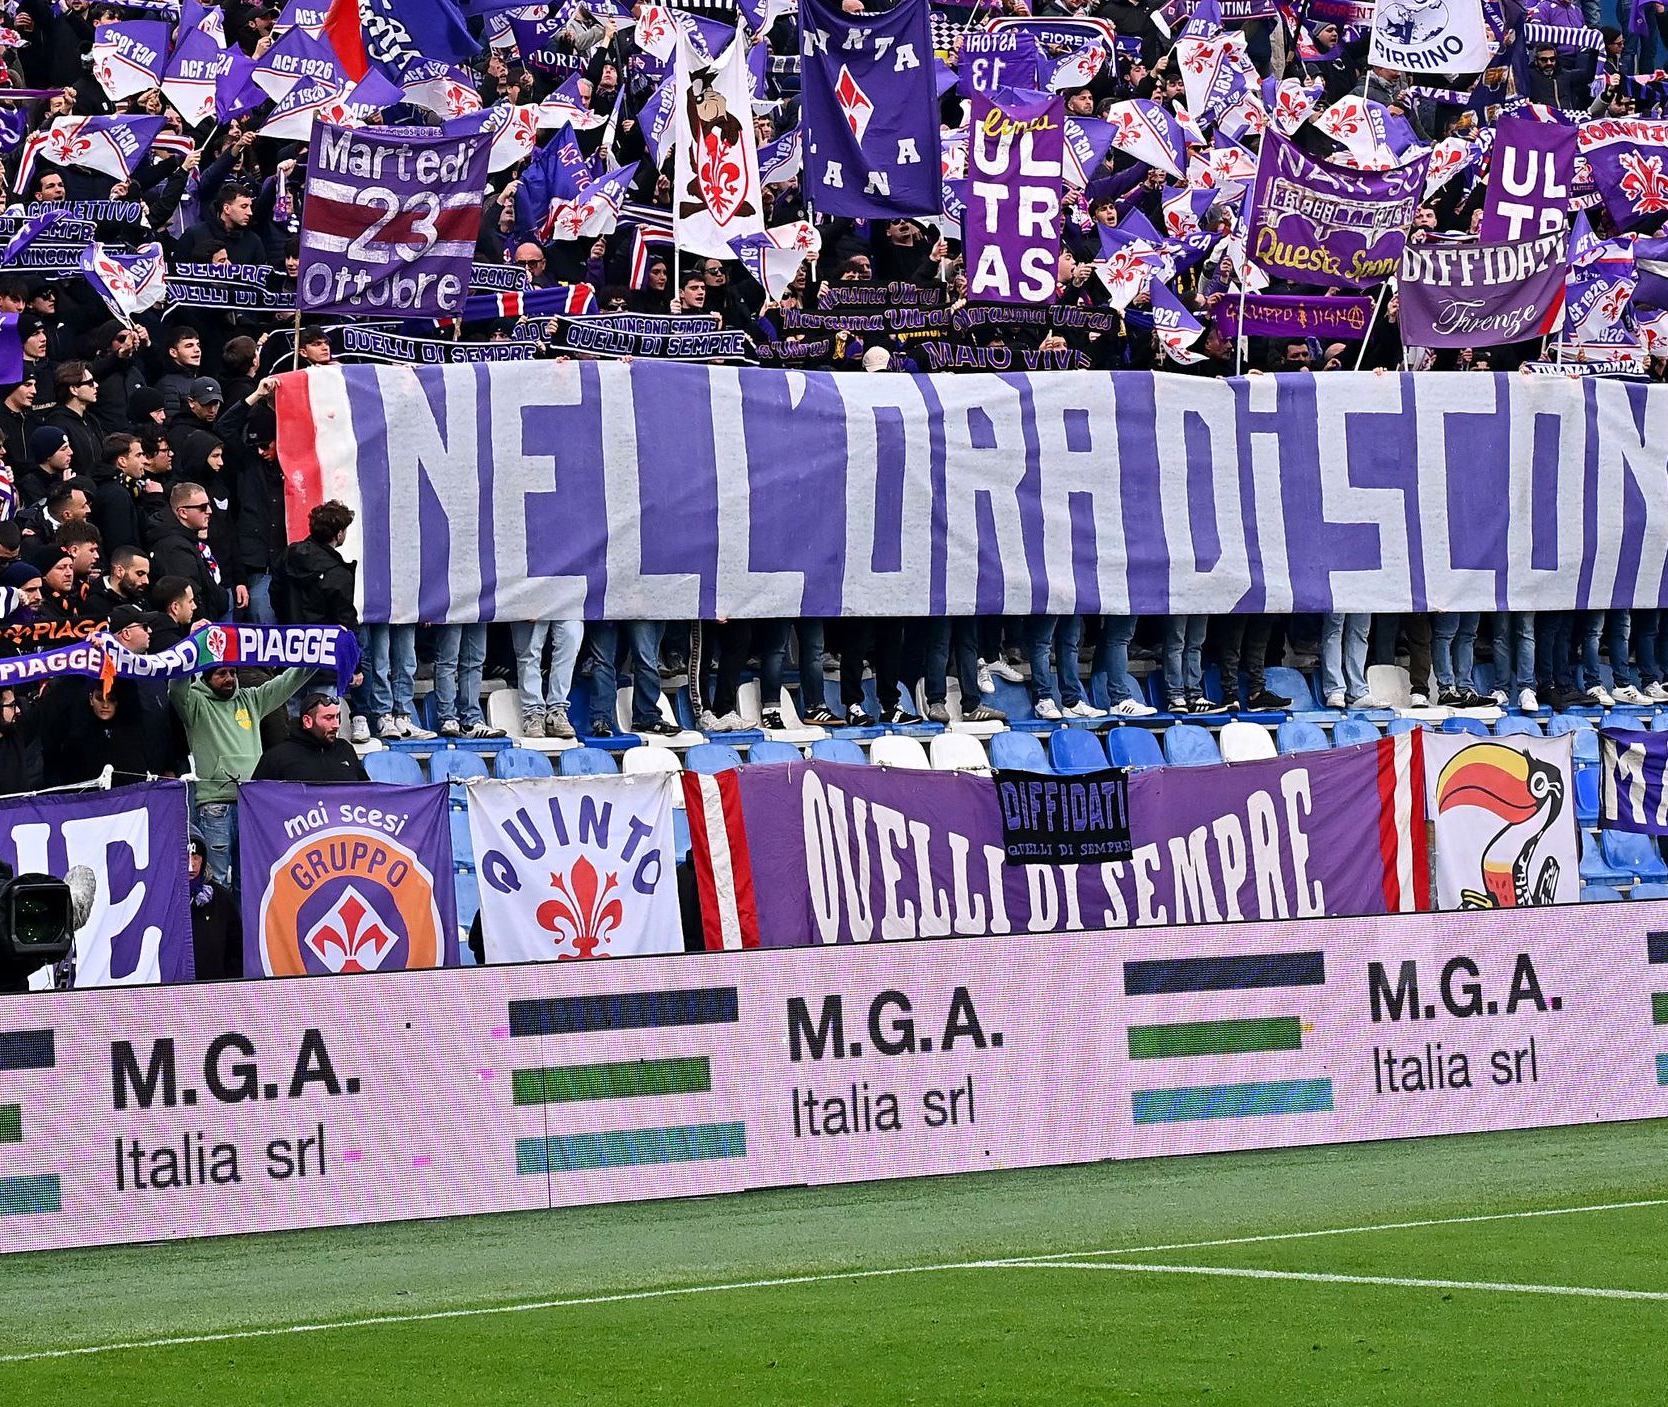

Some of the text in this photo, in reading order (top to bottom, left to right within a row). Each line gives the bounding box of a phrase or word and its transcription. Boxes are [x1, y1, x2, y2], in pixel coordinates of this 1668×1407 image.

[273, 54, 334, 77] ACF 1926
[973, 123, 1063, 178] UL
[28, 201, 141, 223] COLLETTIVO
[347, 188, 441, 264] 23
[971, 184, 1061, 240] TR
[177, 262, 268, 285] SEMPRE
[303, 267, 461, 310] Ottobre
[971, 244, 1060, 303] AS
[343, 329, 534, 361] QUELLI DI SEMPRE
[564, 333, 745, 354] QUELLI DI SEMPRE
[1431, 298, 1538, 338] Firenze
[0, 642, 102, 680] PIAGGE
[106, 628, 337, 678] GRUPPO PIAGGE
[283, 803, 410, 840] mai scesi
[1004, 779, 1128, 839] DIFFIDATI
[290, 842, 412, 891] GRUPPO
[480, 793, 664, 898] QUINTO
[1101, 767, 1326, 930] SEMPRE
[1368, 953, 1564, 1023] M.G.A.
[787, 985, 1005, 1062] M.G.A.
[109, 1027, 362, 1110] M.G.A.
[1372, 1036, 1539, 1095] Italia srl
[792, 1075, 976, 1138] Italia srl
[114, 1120, 328, 1192] Italia srl
